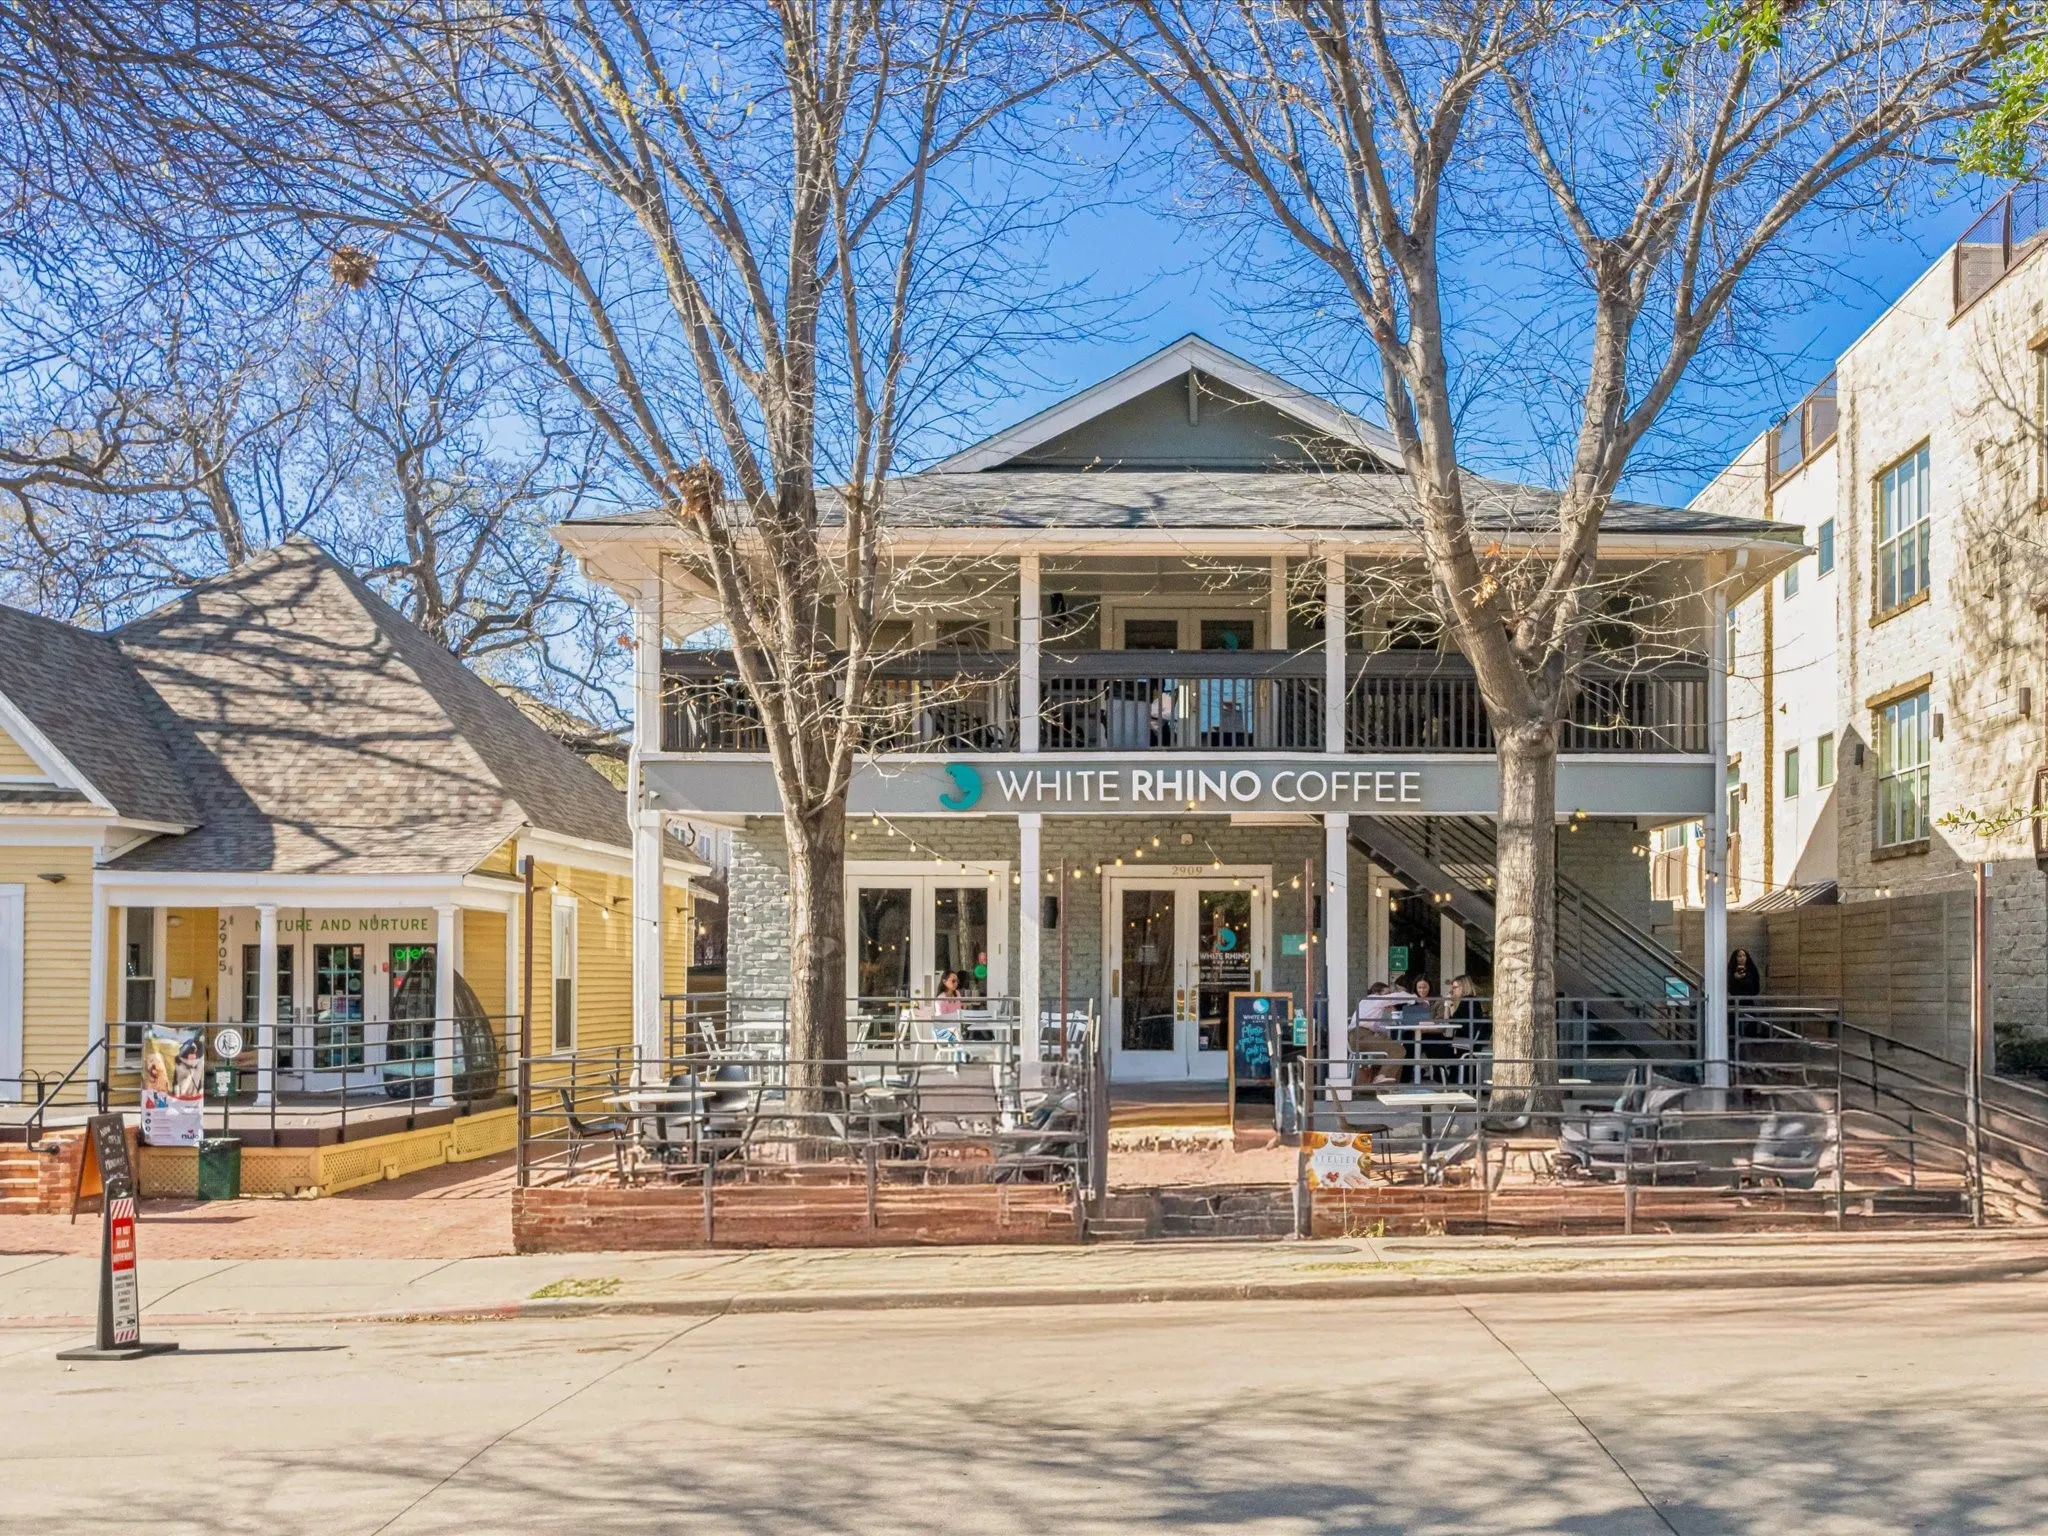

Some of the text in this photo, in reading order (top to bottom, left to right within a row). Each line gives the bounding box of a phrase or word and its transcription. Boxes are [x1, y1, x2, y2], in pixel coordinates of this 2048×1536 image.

[996, 770, 1421, 803] WHITE RHINO COFFEE
[1171, 866, 1203, 875] 2909
[255, 917, 429, 932] NTURE AND NURTURE
[219, 919, 227, 972] 2905
[1224, 952, 1251, 960] RHINO
[181, 1132, 200, 1140] nulo
